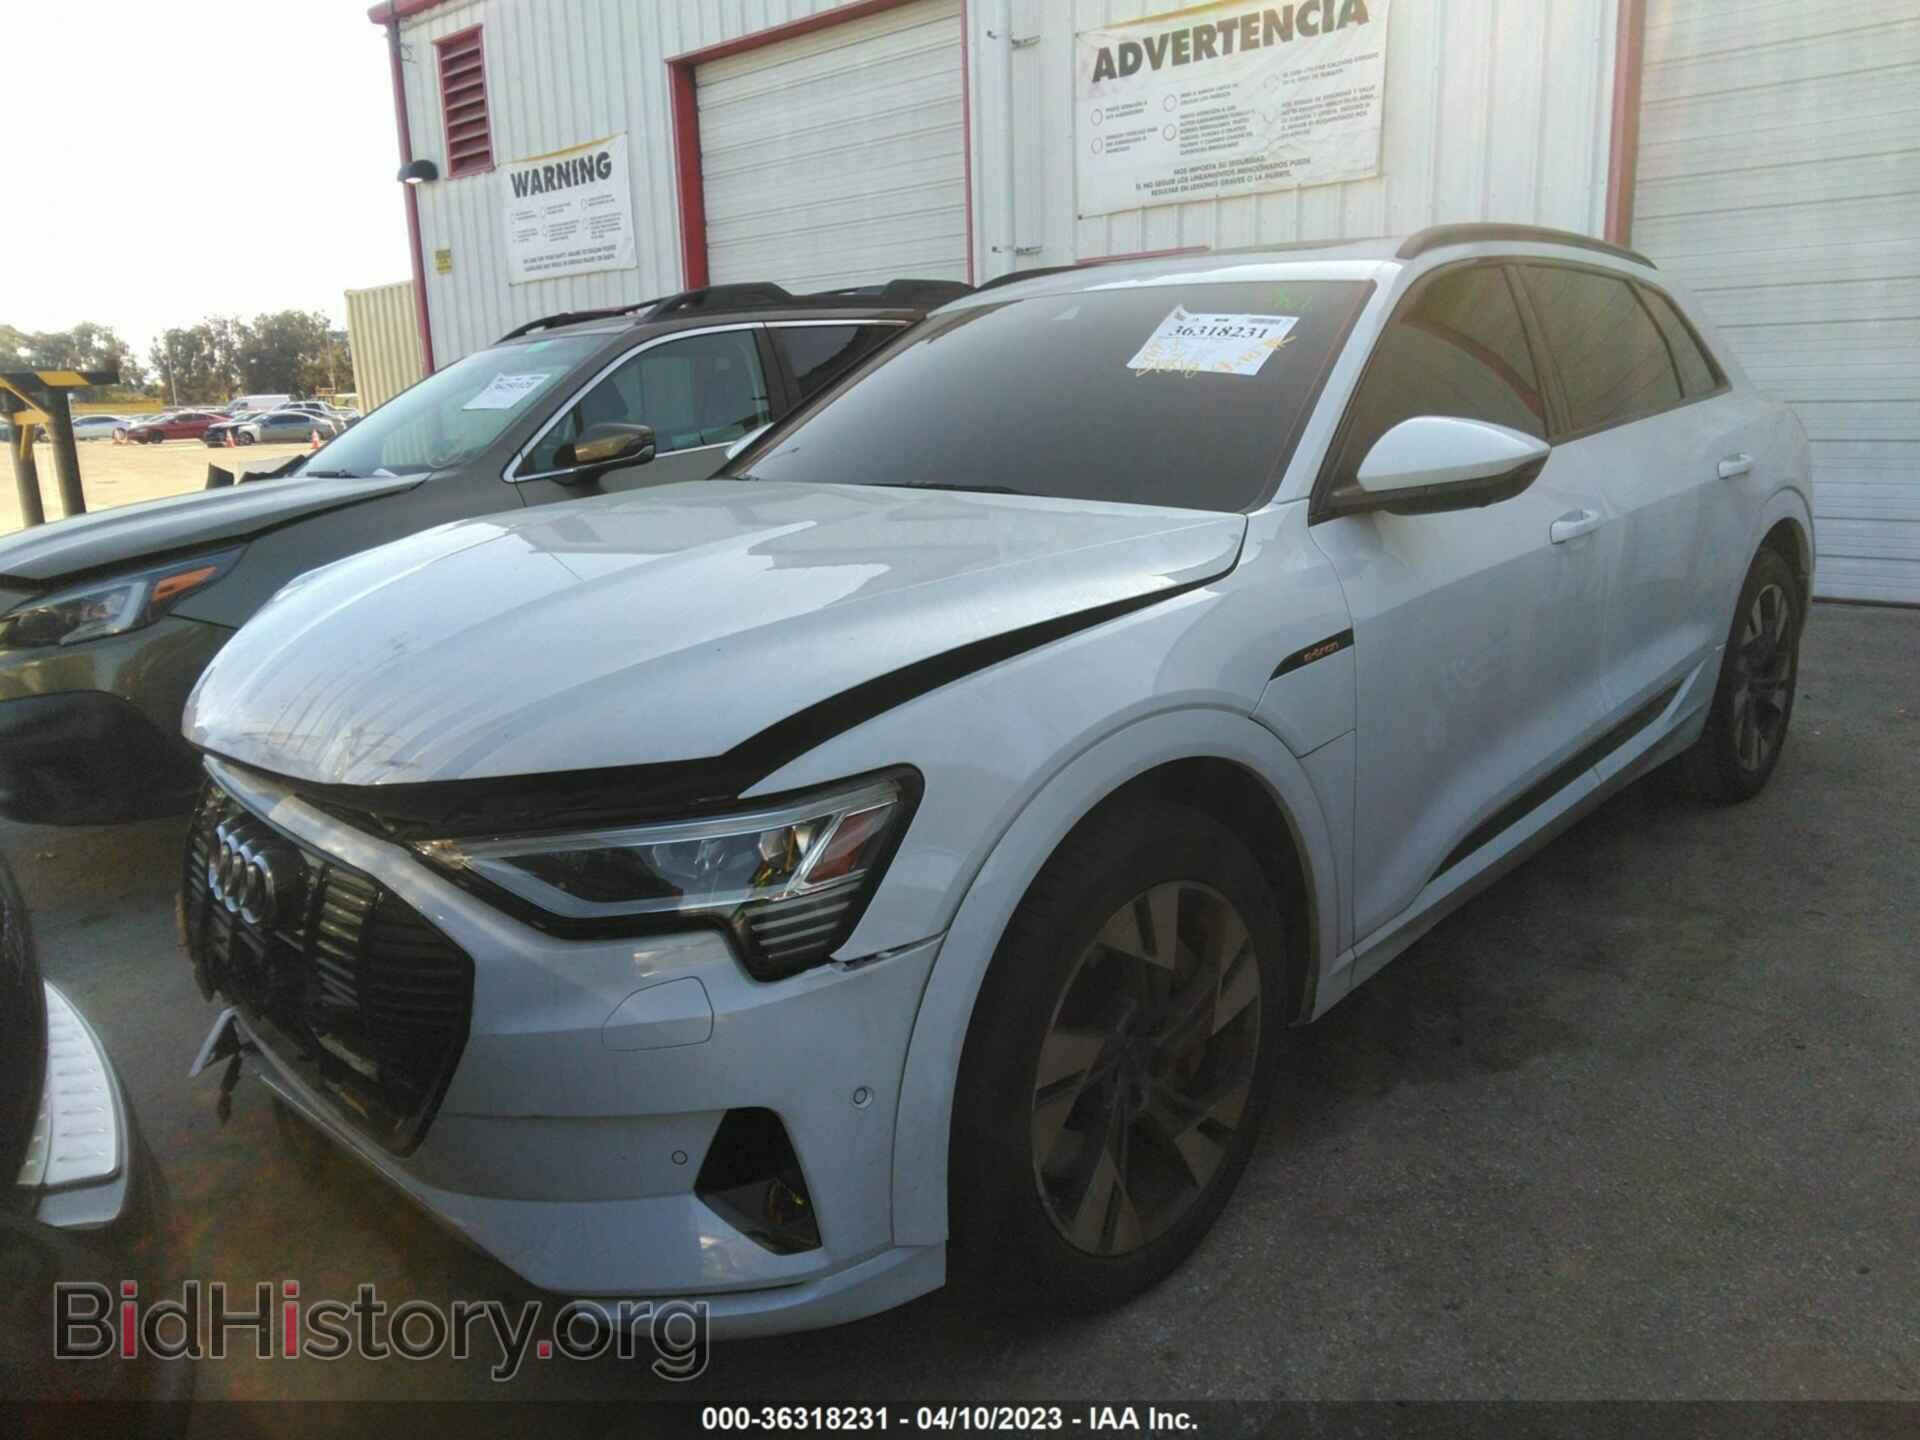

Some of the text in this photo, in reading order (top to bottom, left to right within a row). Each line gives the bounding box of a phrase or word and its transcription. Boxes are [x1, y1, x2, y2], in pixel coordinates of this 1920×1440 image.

[1091, 0, 1371, 83] ADVERTENCIA
[510, 151, 612, 199] WARNING
[1168, 325, 1269, 339] 36318231
